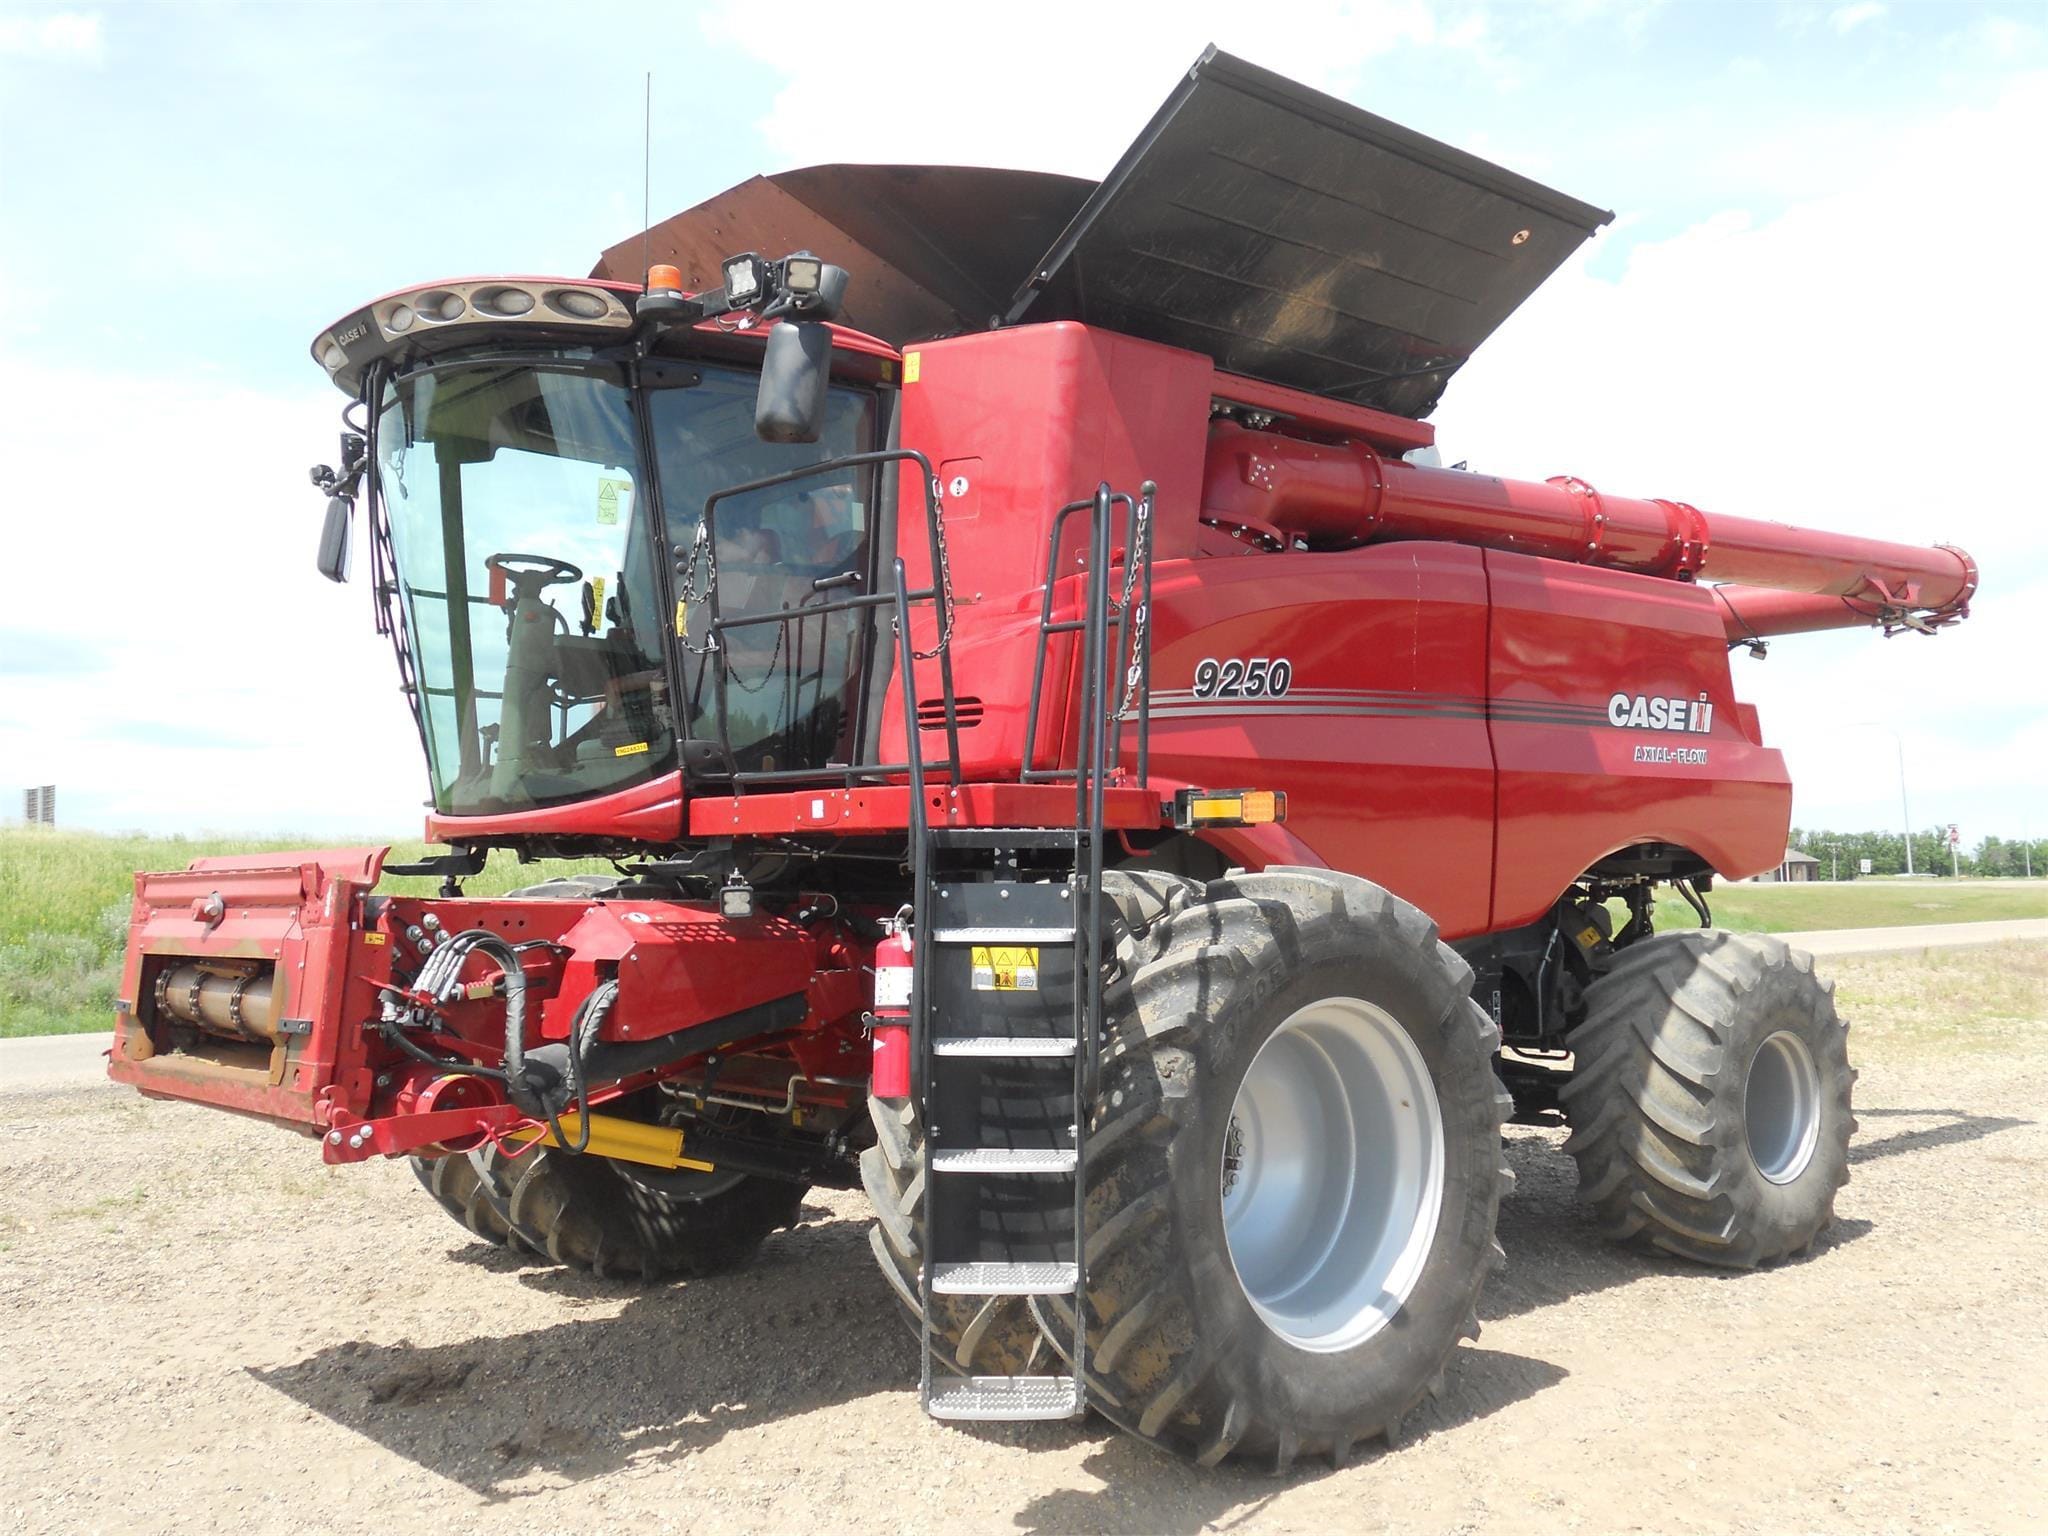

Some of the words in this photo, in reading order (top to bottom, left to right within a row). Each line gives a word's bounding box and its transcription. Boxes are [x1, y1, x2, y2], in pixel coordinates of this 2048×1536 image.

[338, 328, 360, 346] CASE
[1193, 658, 1292, 699] 9250
[1608, 693, 1687, 731] CASE
[1634, 745, 1707, 764] AXIAL-FLOW
